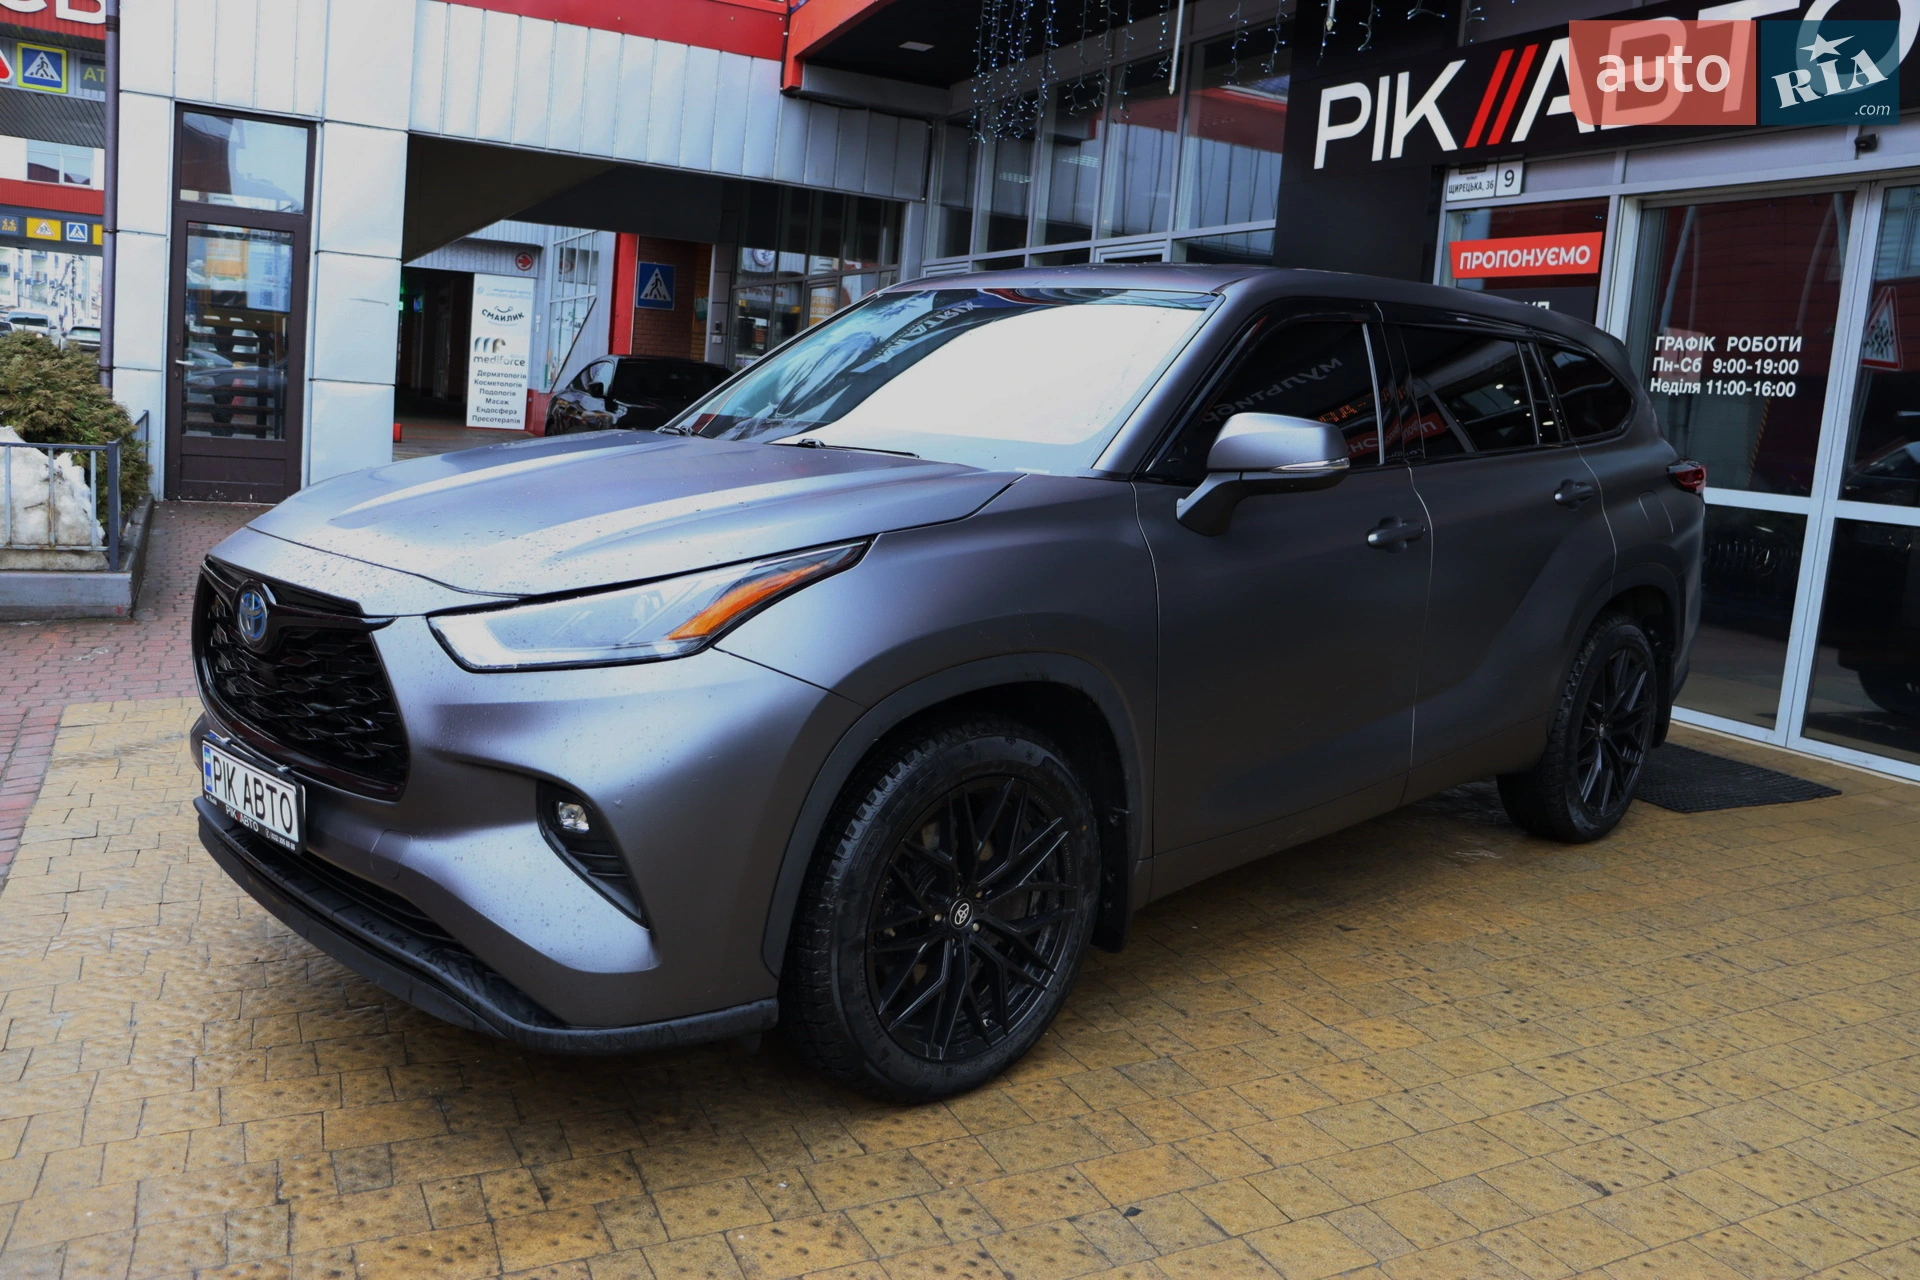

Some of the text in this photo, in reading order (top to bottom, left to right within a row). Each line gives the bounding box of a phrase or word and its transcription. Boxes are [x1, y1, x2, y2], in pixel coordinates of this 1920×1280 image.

[1504, 169, 1515, 188] 9
[1485, 180, 1494, 190] 36
[1459, 245, 1591, 270] ПРОПОНУЄМО
[1655, 336, 1802, 352] ГРАФІК РОБОТИ
[473, 355, 526, 367] mediforce
[1652, 357, 1800, 375] Пн-Сб 9:00-19:00
[476, 369, 527, 379] Дерматологія
[474, 378, 523, 388] Косметологія
[1650, 378, 1796, 397] Неділя 11:00-16:00
[479, 388, 517, 397] Подологія
[476, 406, 518, 415] Ендосфера
[472, 415, 521, 424] Пресотерапія
